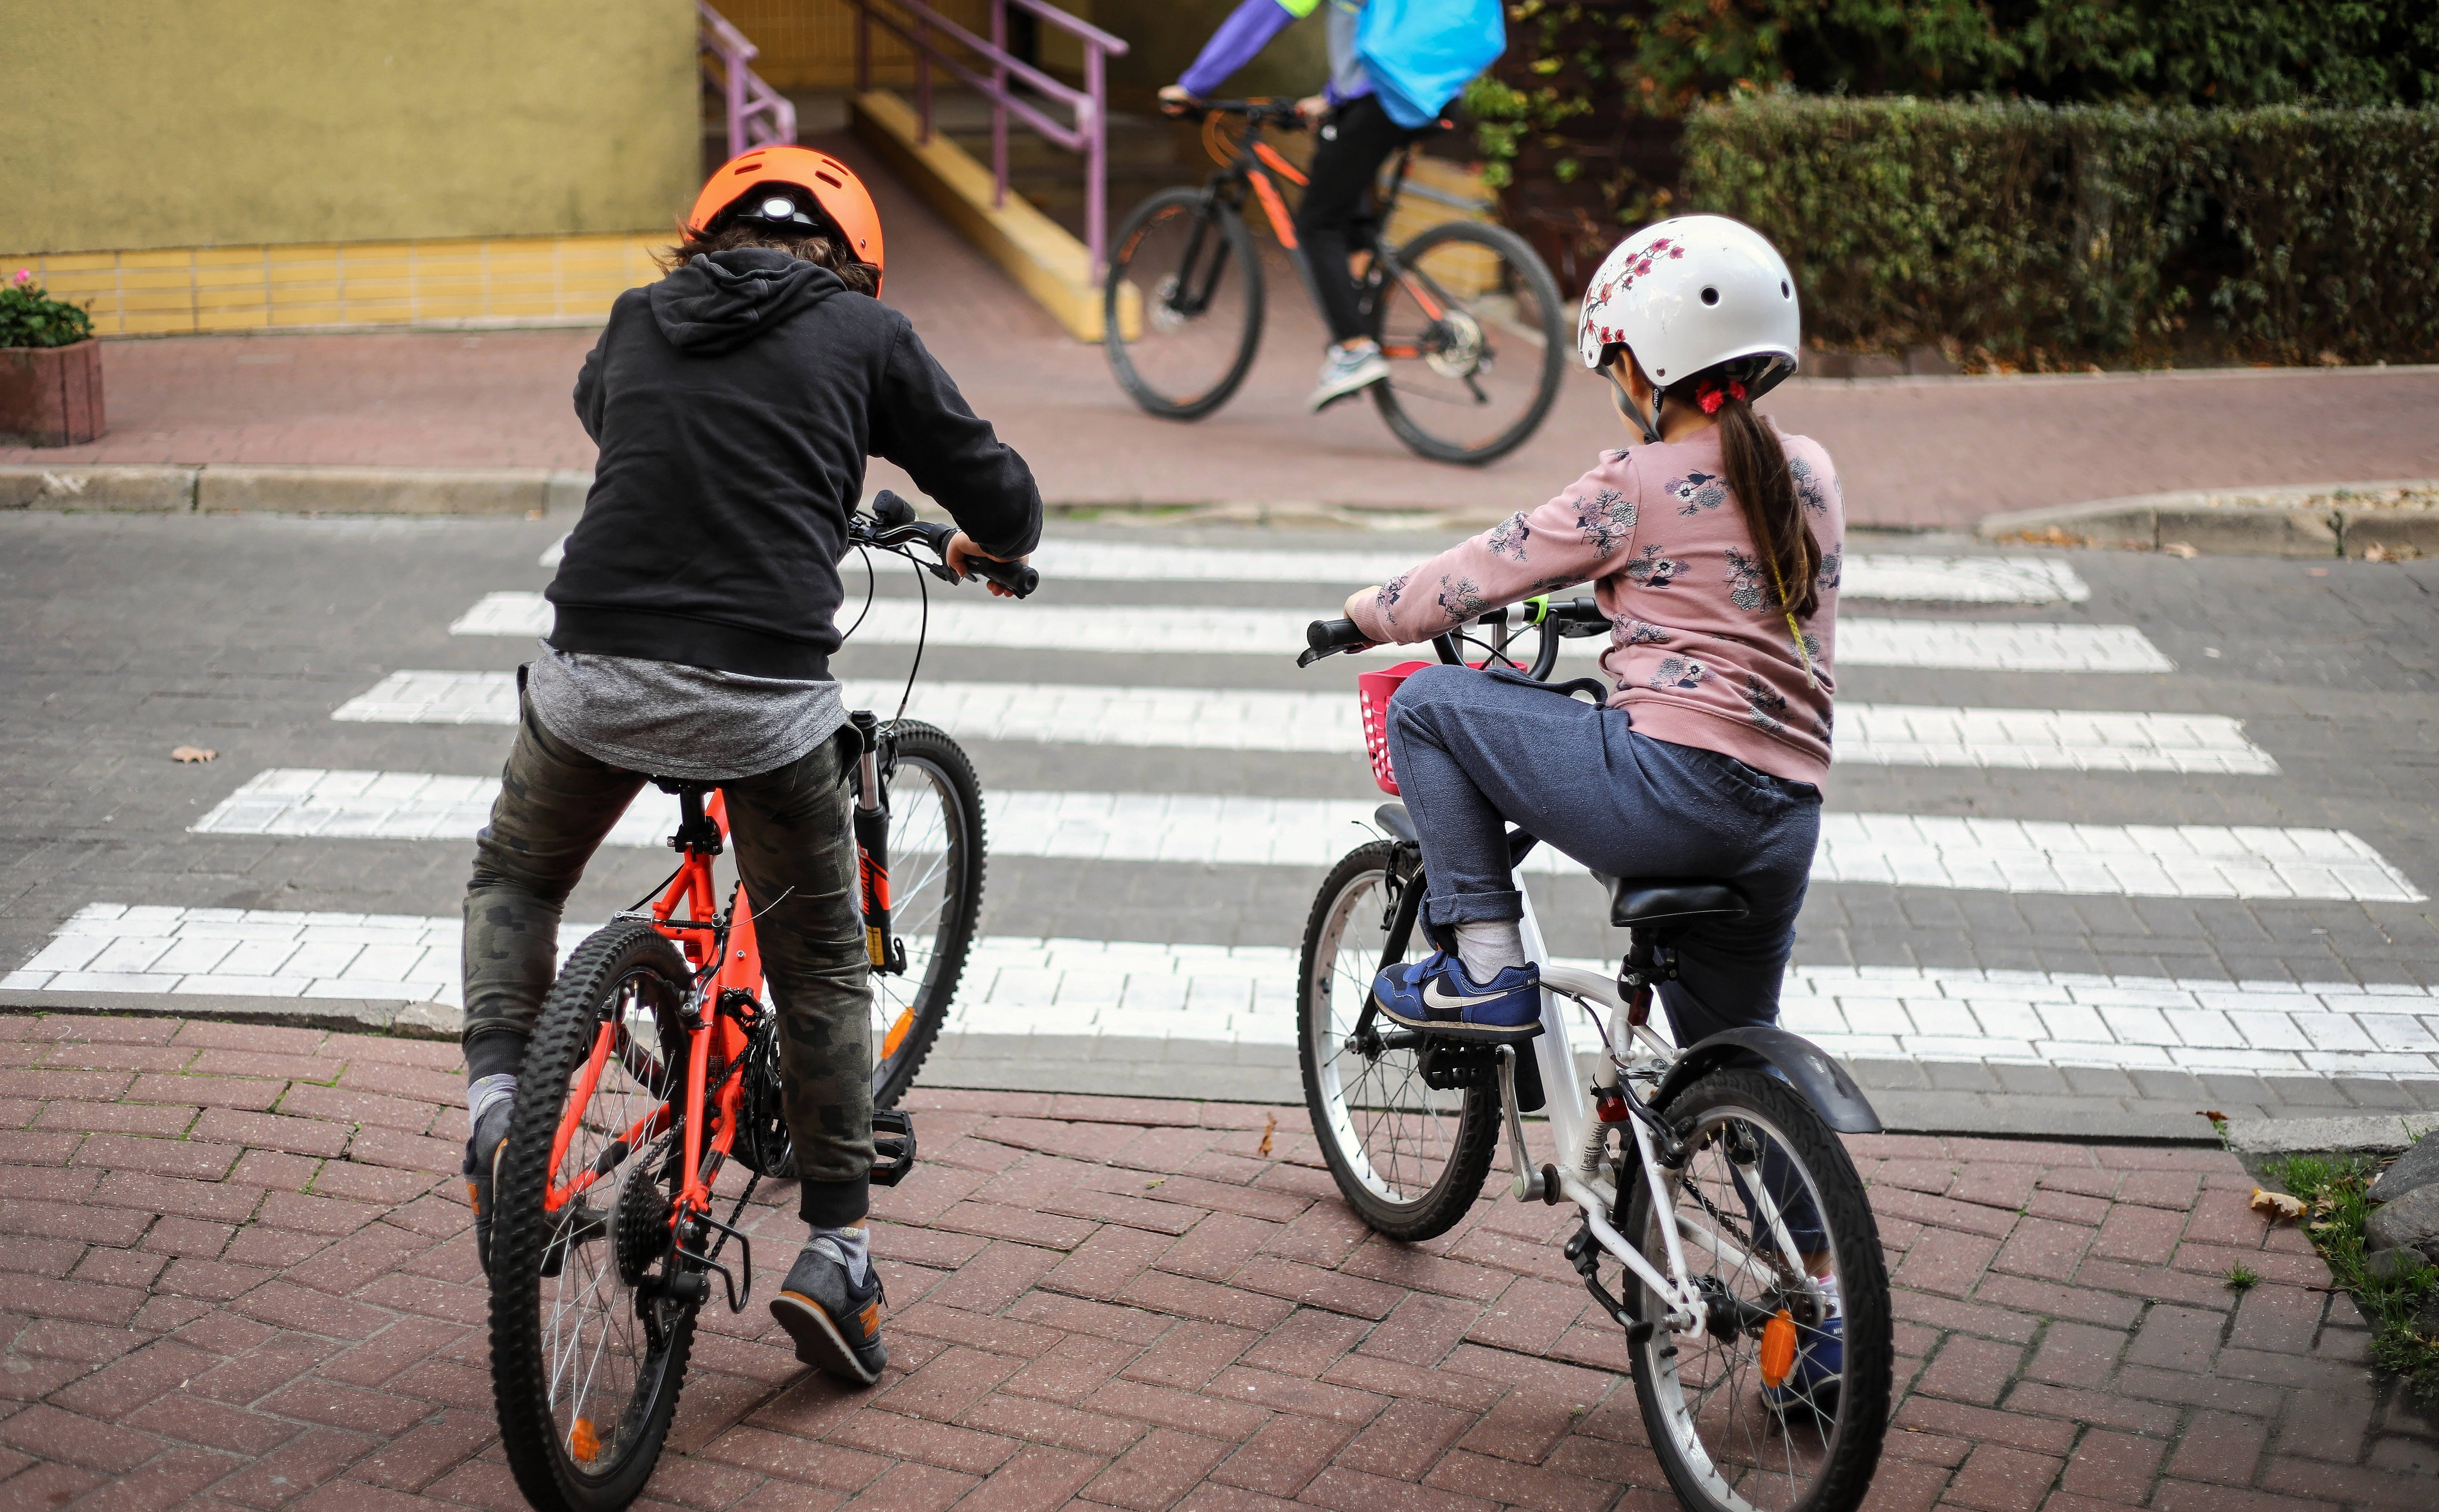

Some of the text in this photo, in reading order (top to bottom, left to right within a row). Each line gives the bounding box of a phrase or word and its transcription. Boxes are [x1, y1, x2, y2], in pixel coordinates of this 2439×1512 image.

[1527, 977, 1536, 986] NIKE
[816, 1238, 832, 1247] new
[808, 1242, 834, 1255] balance
